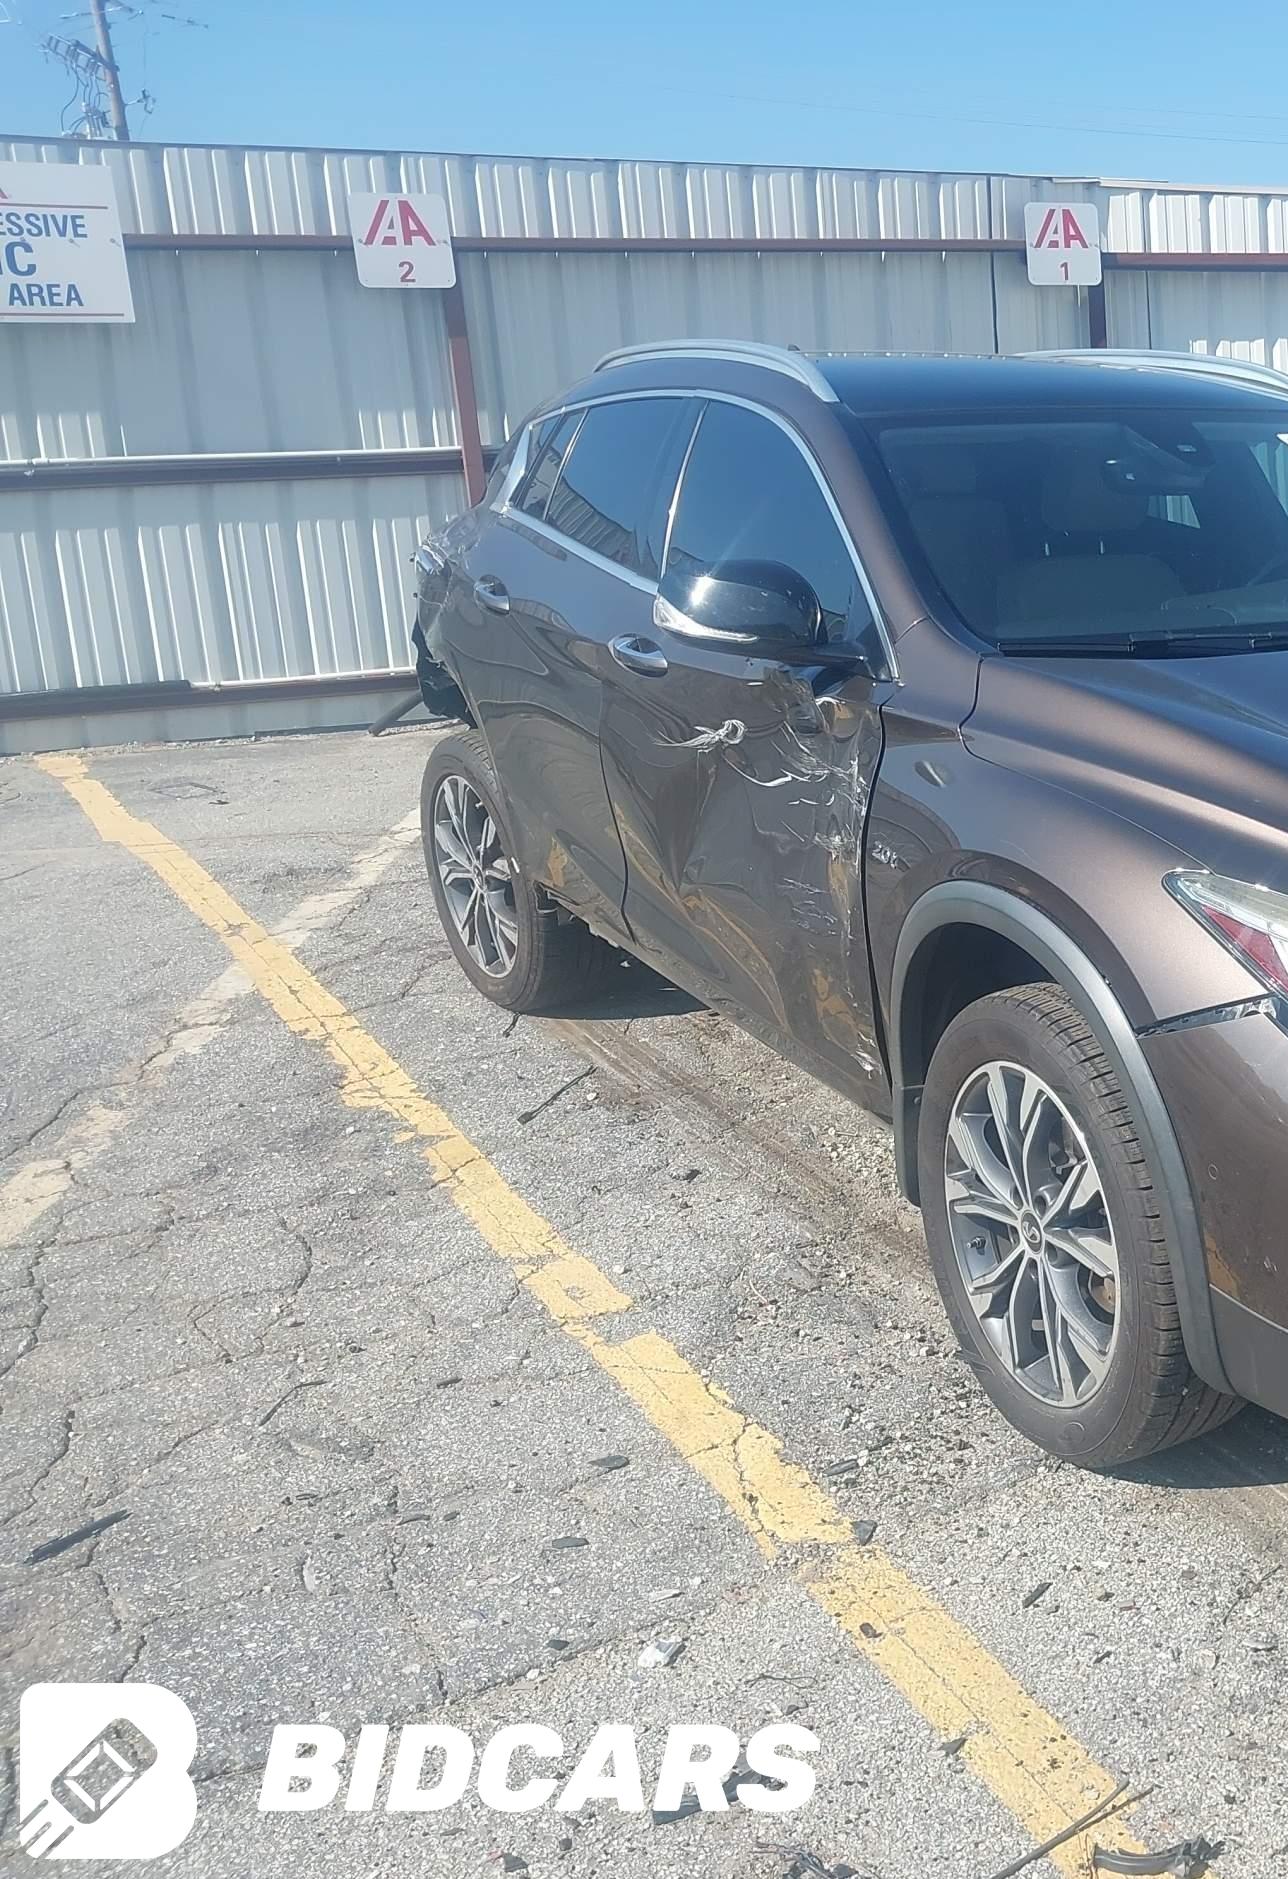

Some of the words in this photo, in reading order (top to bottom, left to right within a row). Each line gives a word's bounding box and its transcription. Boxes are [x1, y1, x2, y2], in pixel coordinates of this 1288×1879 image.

[0, 241, 37, 276] C
[398, 261, 416, 283] 2
[1059, 261, 1069, 281] 1
[8, 282, 84, 307] AREA
